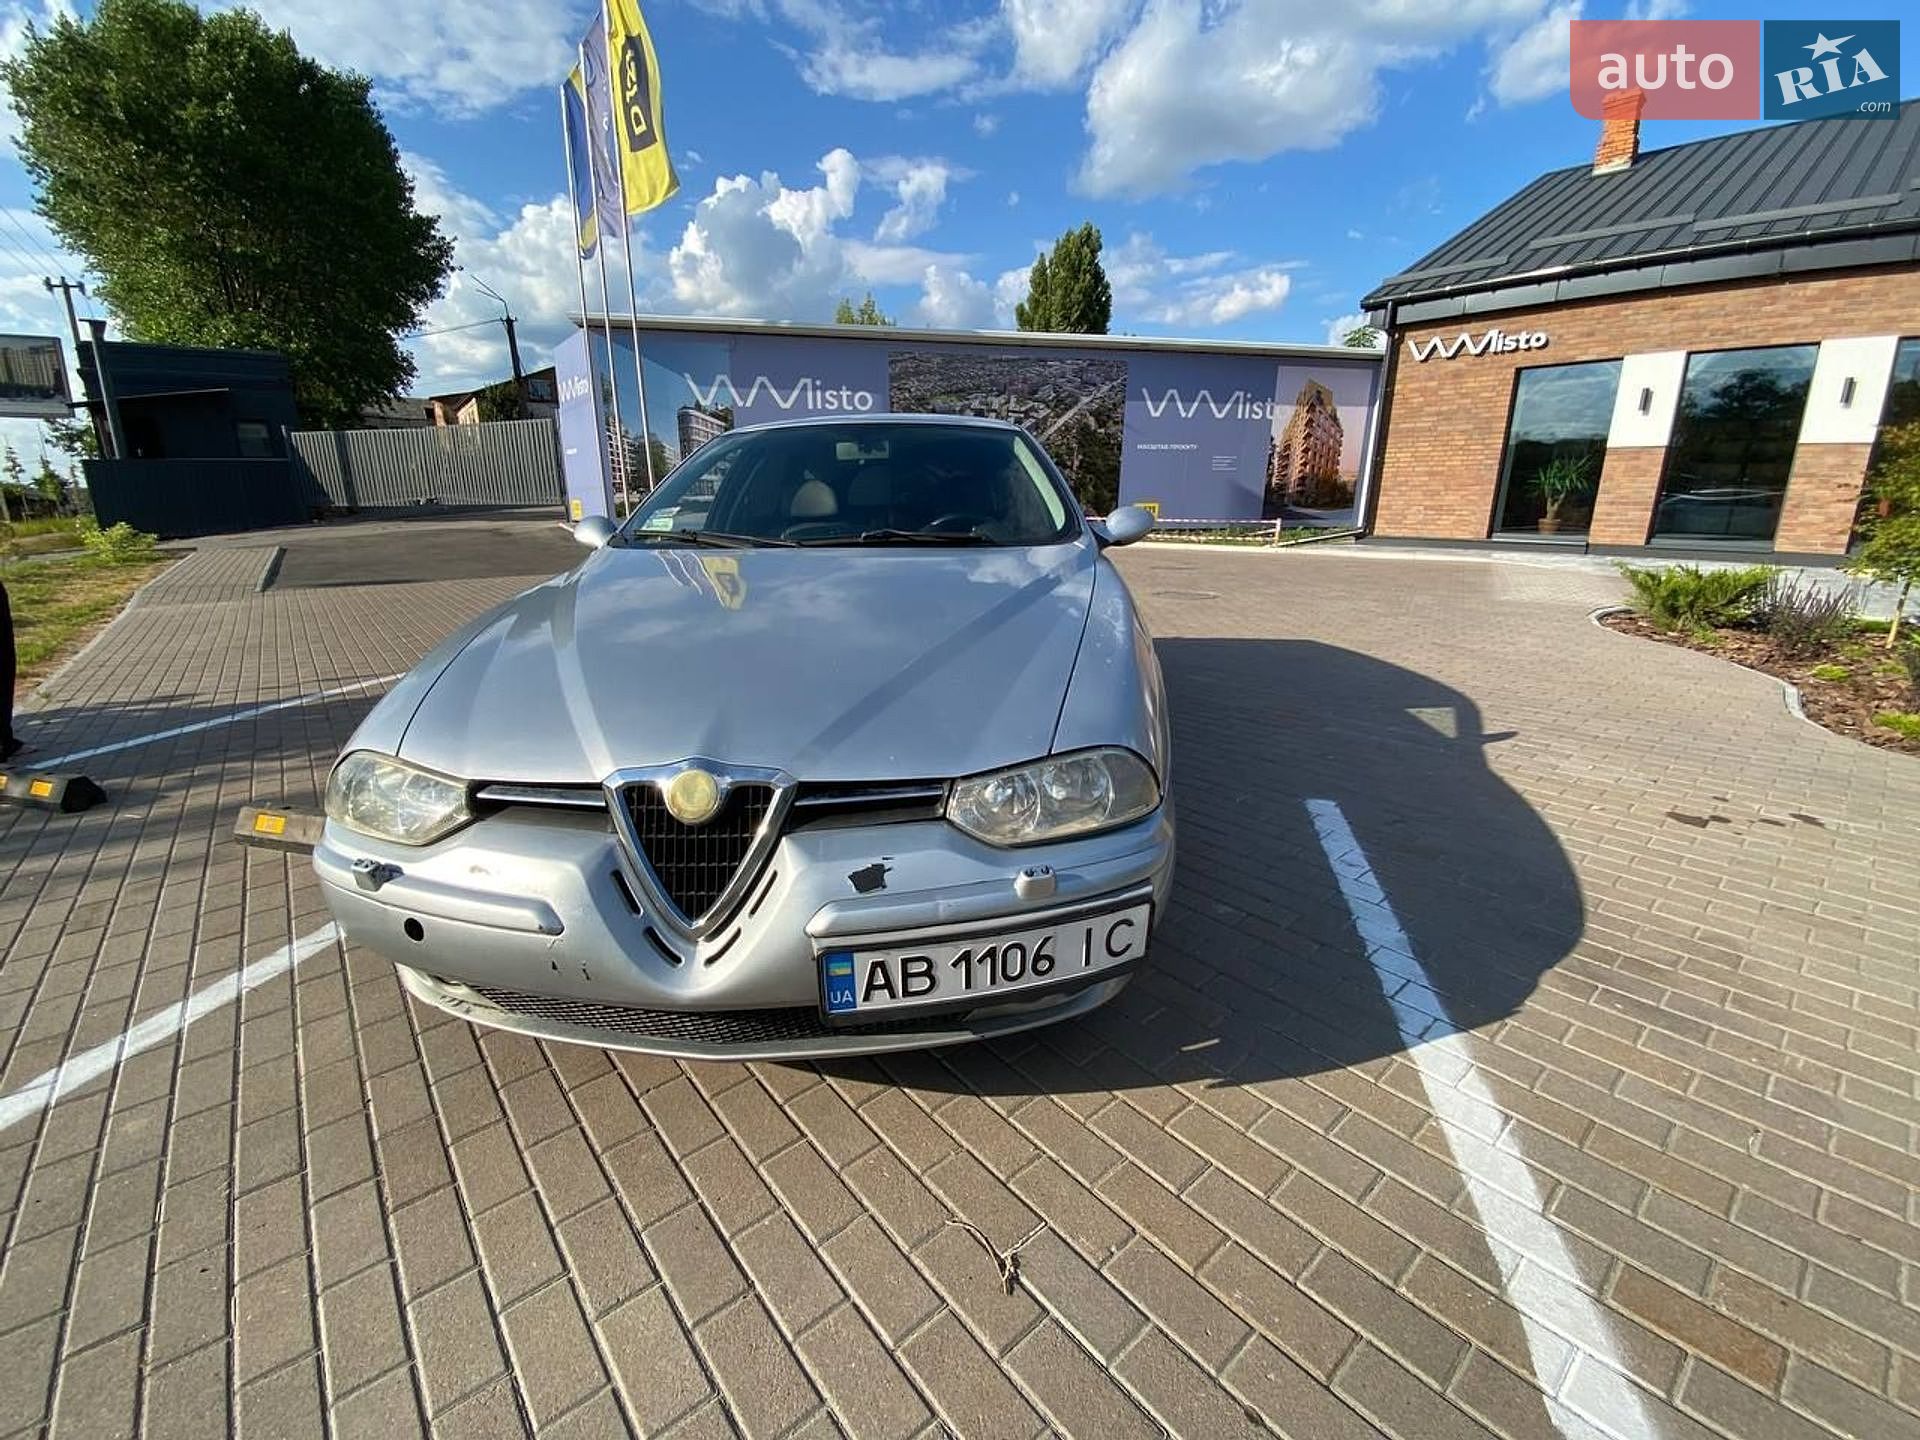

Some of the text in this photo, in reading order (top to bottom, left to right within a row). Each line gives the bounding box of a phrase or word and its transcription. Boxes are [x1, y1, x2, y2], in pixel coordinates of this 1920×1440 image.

[862, 918, 1135, 1002] AB 1106 IC
[830, 989, 853, 1005] UA
